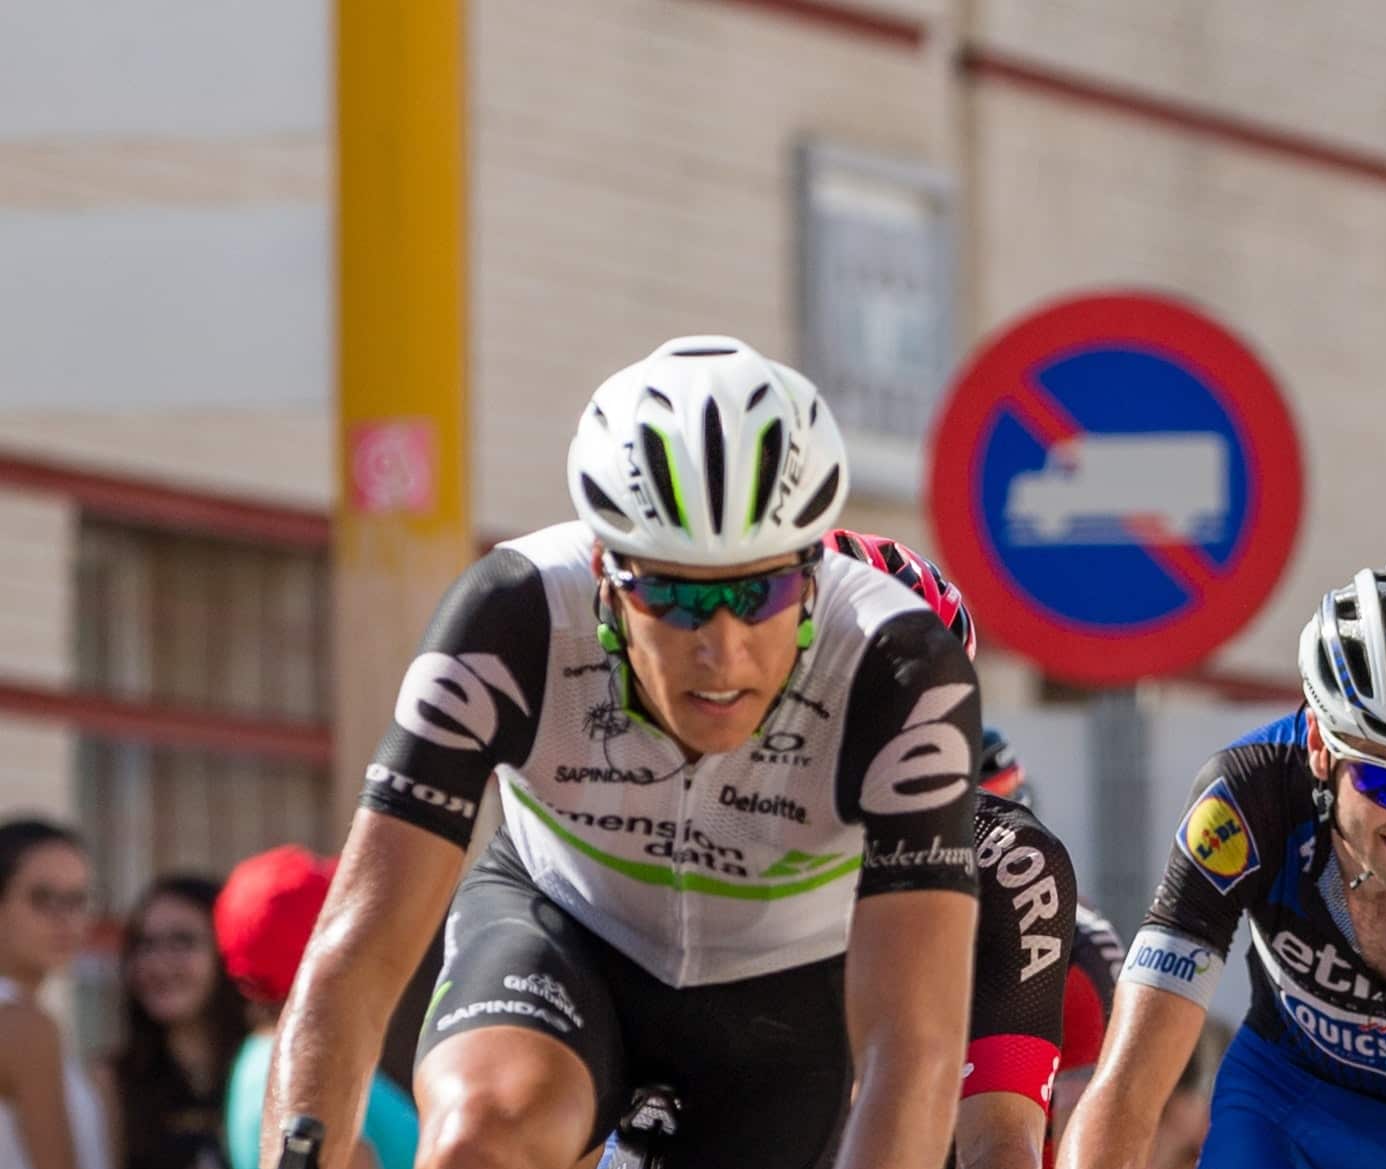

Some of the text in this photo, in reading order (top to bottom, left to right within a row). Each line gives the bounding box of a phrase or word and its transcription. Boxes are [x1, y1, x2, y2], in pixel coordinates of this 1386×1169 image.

[623, 441, 664, 526] MET
[771, 432, 801, 526] MET
[365, 763, 476, 819] OTOR
[977, 826, 1062, 982] BORA
